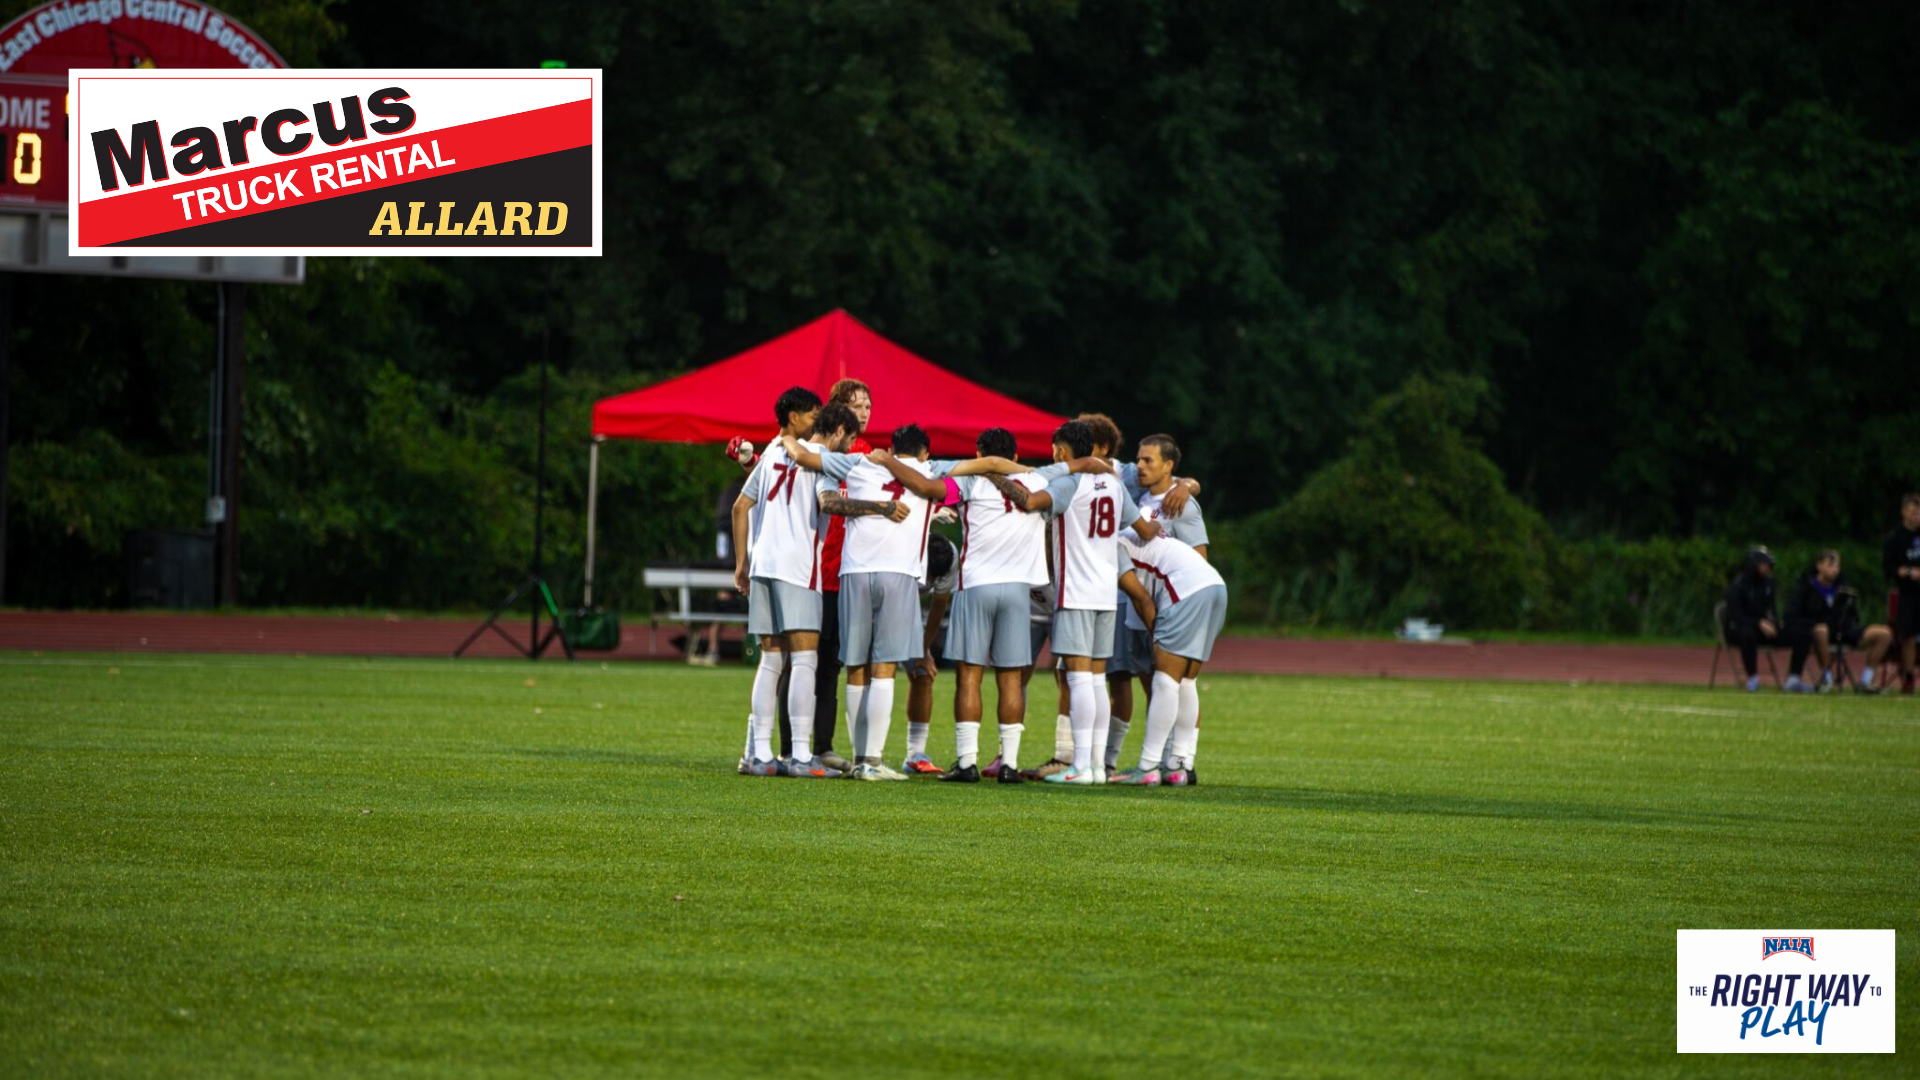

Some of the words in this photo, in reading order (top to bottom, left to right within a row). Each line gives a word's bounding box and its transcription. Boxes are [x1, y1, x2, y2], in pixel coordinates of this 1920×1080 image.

[35, 0, 122, 38] Chicago
[126, 0, 208, 34] Central
[14, 133, 42, 184] 0
[1088, 496, 1115, 538] 18
